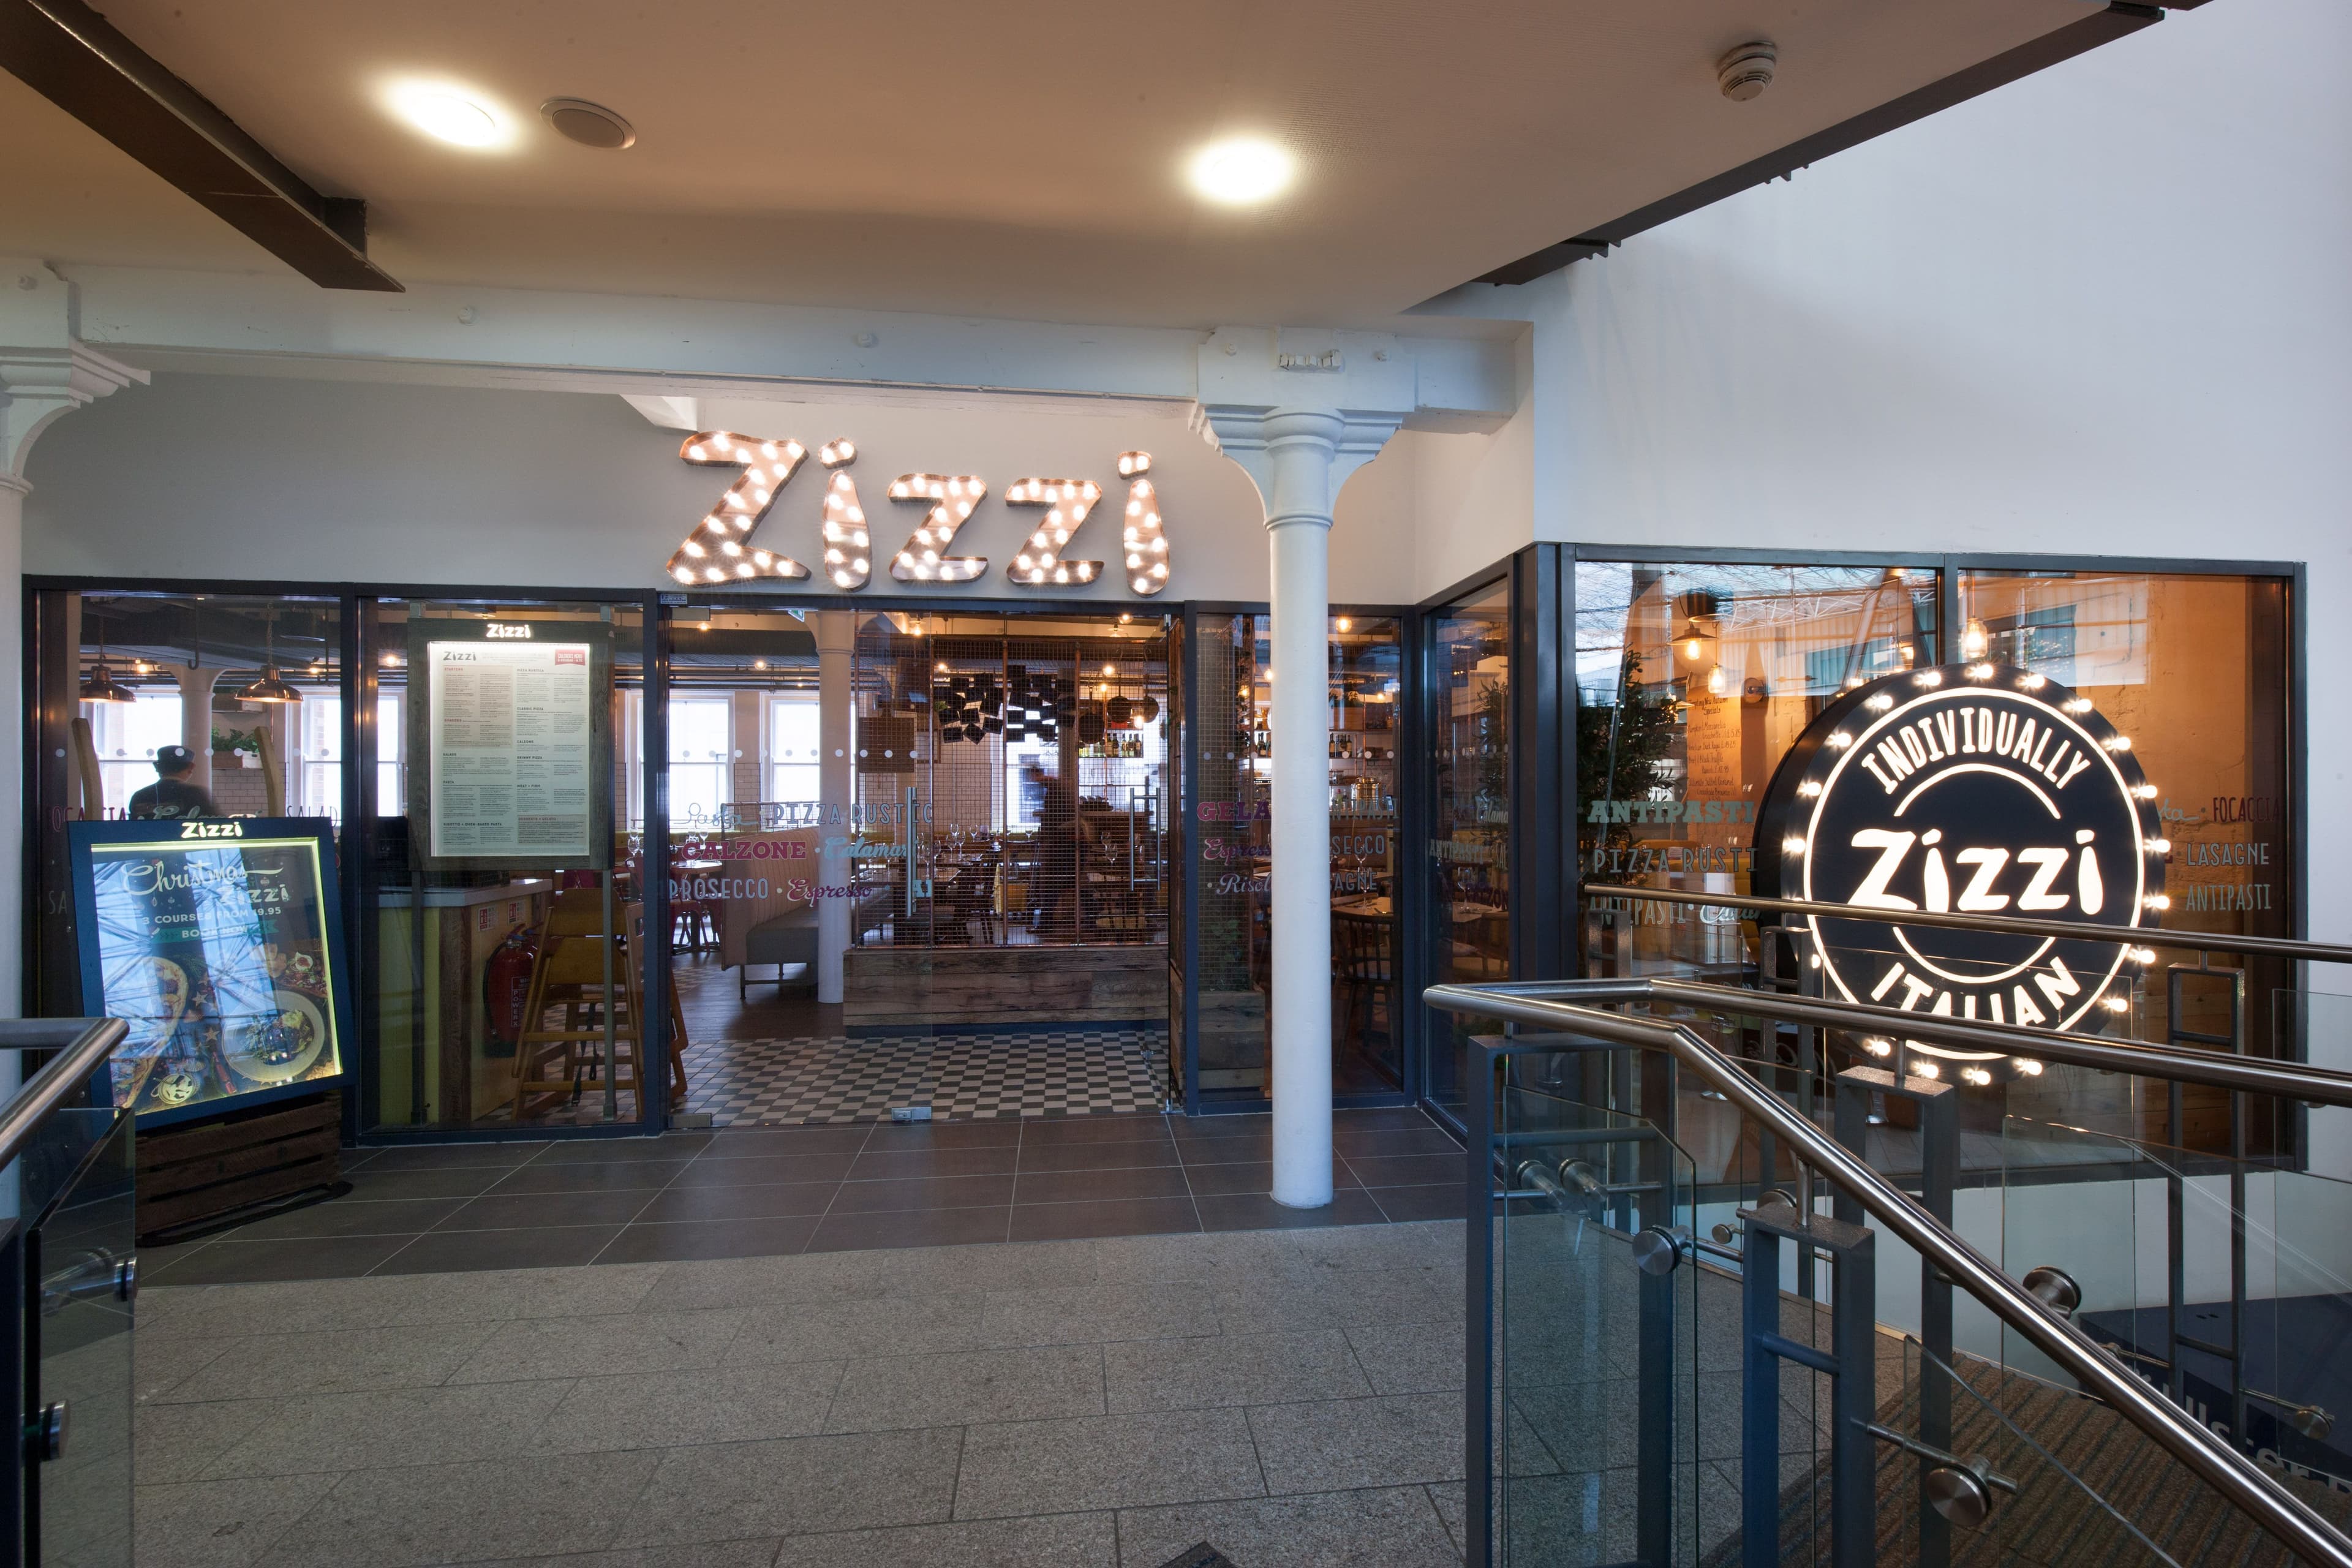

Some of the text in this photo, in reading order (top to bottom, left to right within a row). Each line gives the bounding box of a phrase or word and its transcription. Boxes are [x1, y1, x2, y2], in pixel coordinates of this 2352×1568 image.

[666, 431, 1170, 598] Zizzi
[486, 624, 531, 638] Zizzi
[443, 651, 477, 661] Zizzi
[1861, 706, 2092, 794] INDIVIDUALLY
[673, 802, 932, 826] Pasta PIZZA RUSTIC
[1196, 801, 1272, 822] GELA
[1587, 800, 1755, 824] ANTIPASTI
[2212, 796, 2280, 823] FOCACCIA
[181, 821, 243, 839] Zizzi
[681, 840, 807, 860] CALZONE
[1330, 835, 1385, 856] SECCO
[2186, 842, 2269, 867] LASAGNE
[1594, 848, 1670, 874] PIZZA
[1847, 828, 2105, 915] Zizzi
[122, 860, 284, 896] Christmas
[1330, 872, 1378, 892] AGNE
[215, 884, 290, 904] Zizzi
[668, 878, 769, 900] PROSECCO
[787, 876, 873, 908] Espresso
[2185, 883, 2272, 912] ANTIPASTI
[142, 916, 150, 925] 3
[154, 912, 212, 924] COURSES
[216, 909, 249, 918] FROM
[1871, 956, 2082, 1028] ITALIAN
